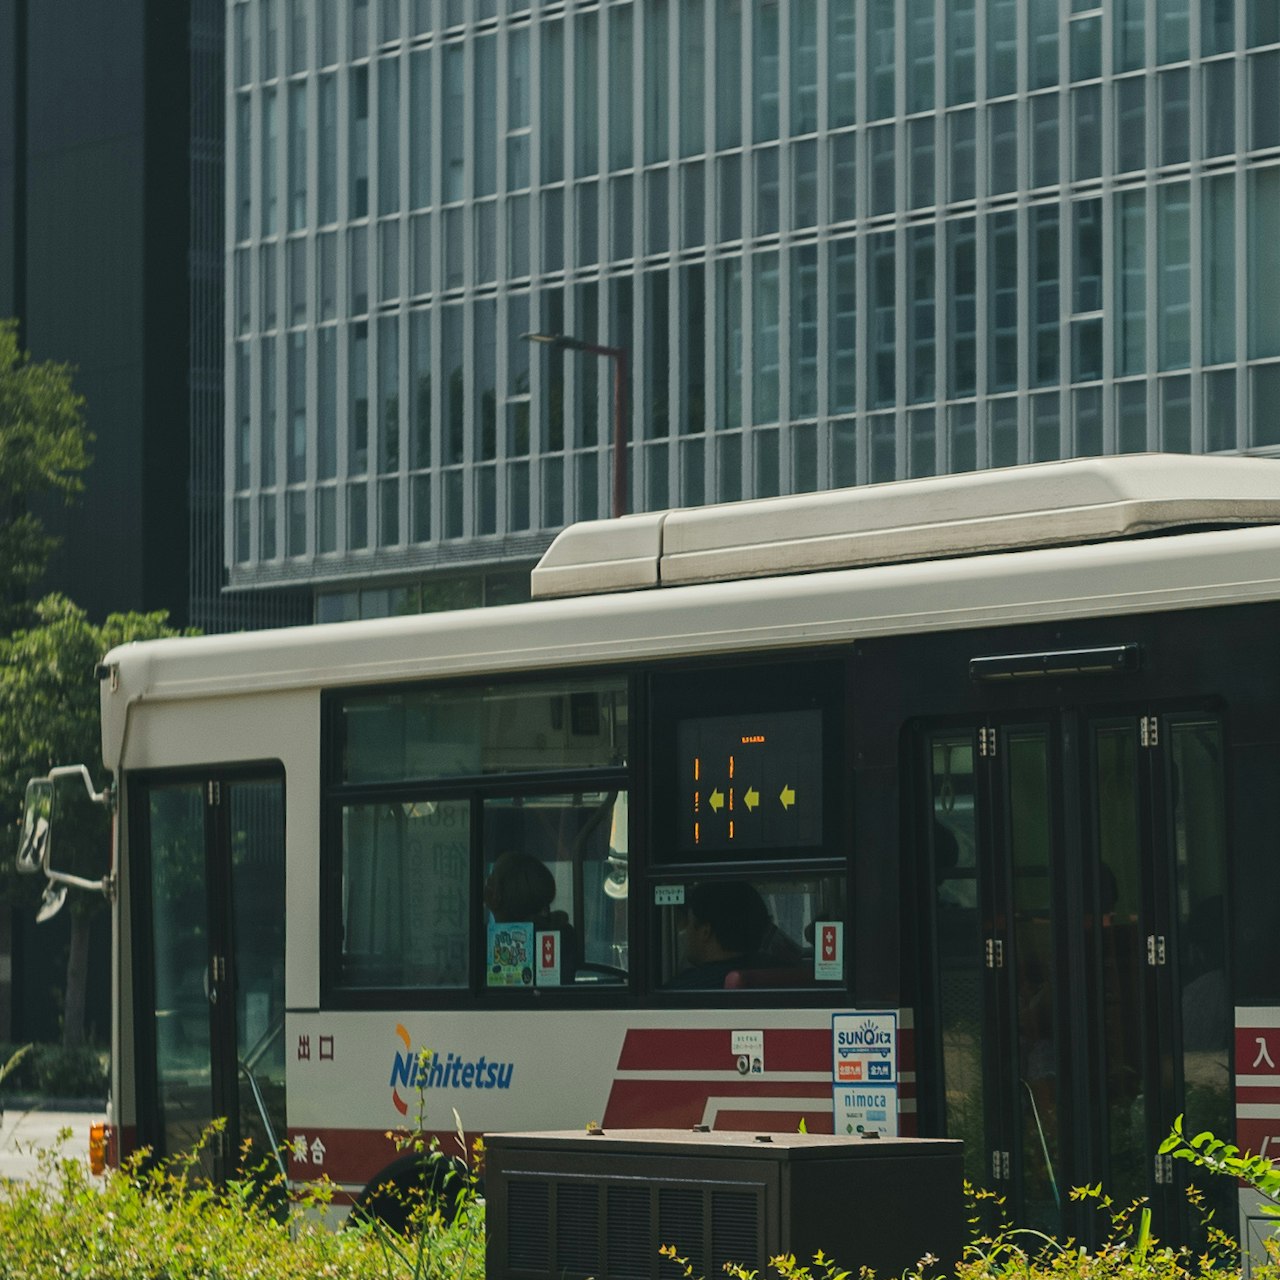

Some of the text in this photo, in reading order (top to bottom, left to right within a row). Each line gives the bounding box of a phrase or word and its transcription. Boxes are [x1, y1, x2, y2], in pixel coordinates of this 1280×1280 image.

[838, 1029, 892, 1045] SUNQパス
[297, 1034, 334, 1061] 出口
[389, 1050, 514, 1088] Nishitetsu
[870, 1065, 888, 1075] 全九州
[845, 1090, 886, 1107] nimoca
